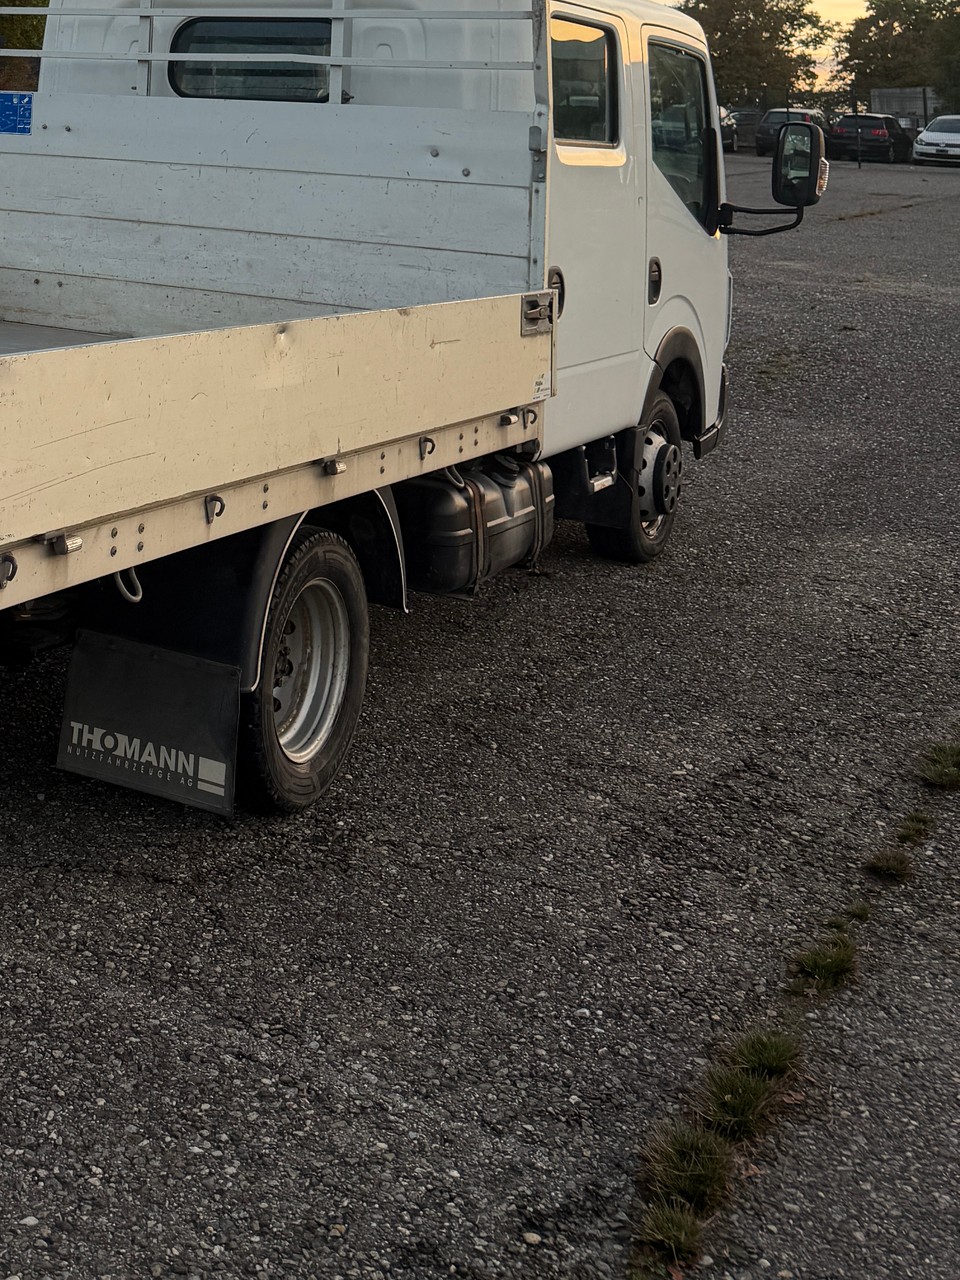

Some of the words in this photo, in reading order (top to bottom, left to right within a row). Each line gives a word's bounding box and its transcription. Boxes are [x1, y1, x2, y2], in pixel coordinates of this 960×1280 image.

[66, 744, 172, 781] NUTZFAHRZEUGE
[179, 776, 194, 787] AG
[70, 721, 195, 777] THOMANN
